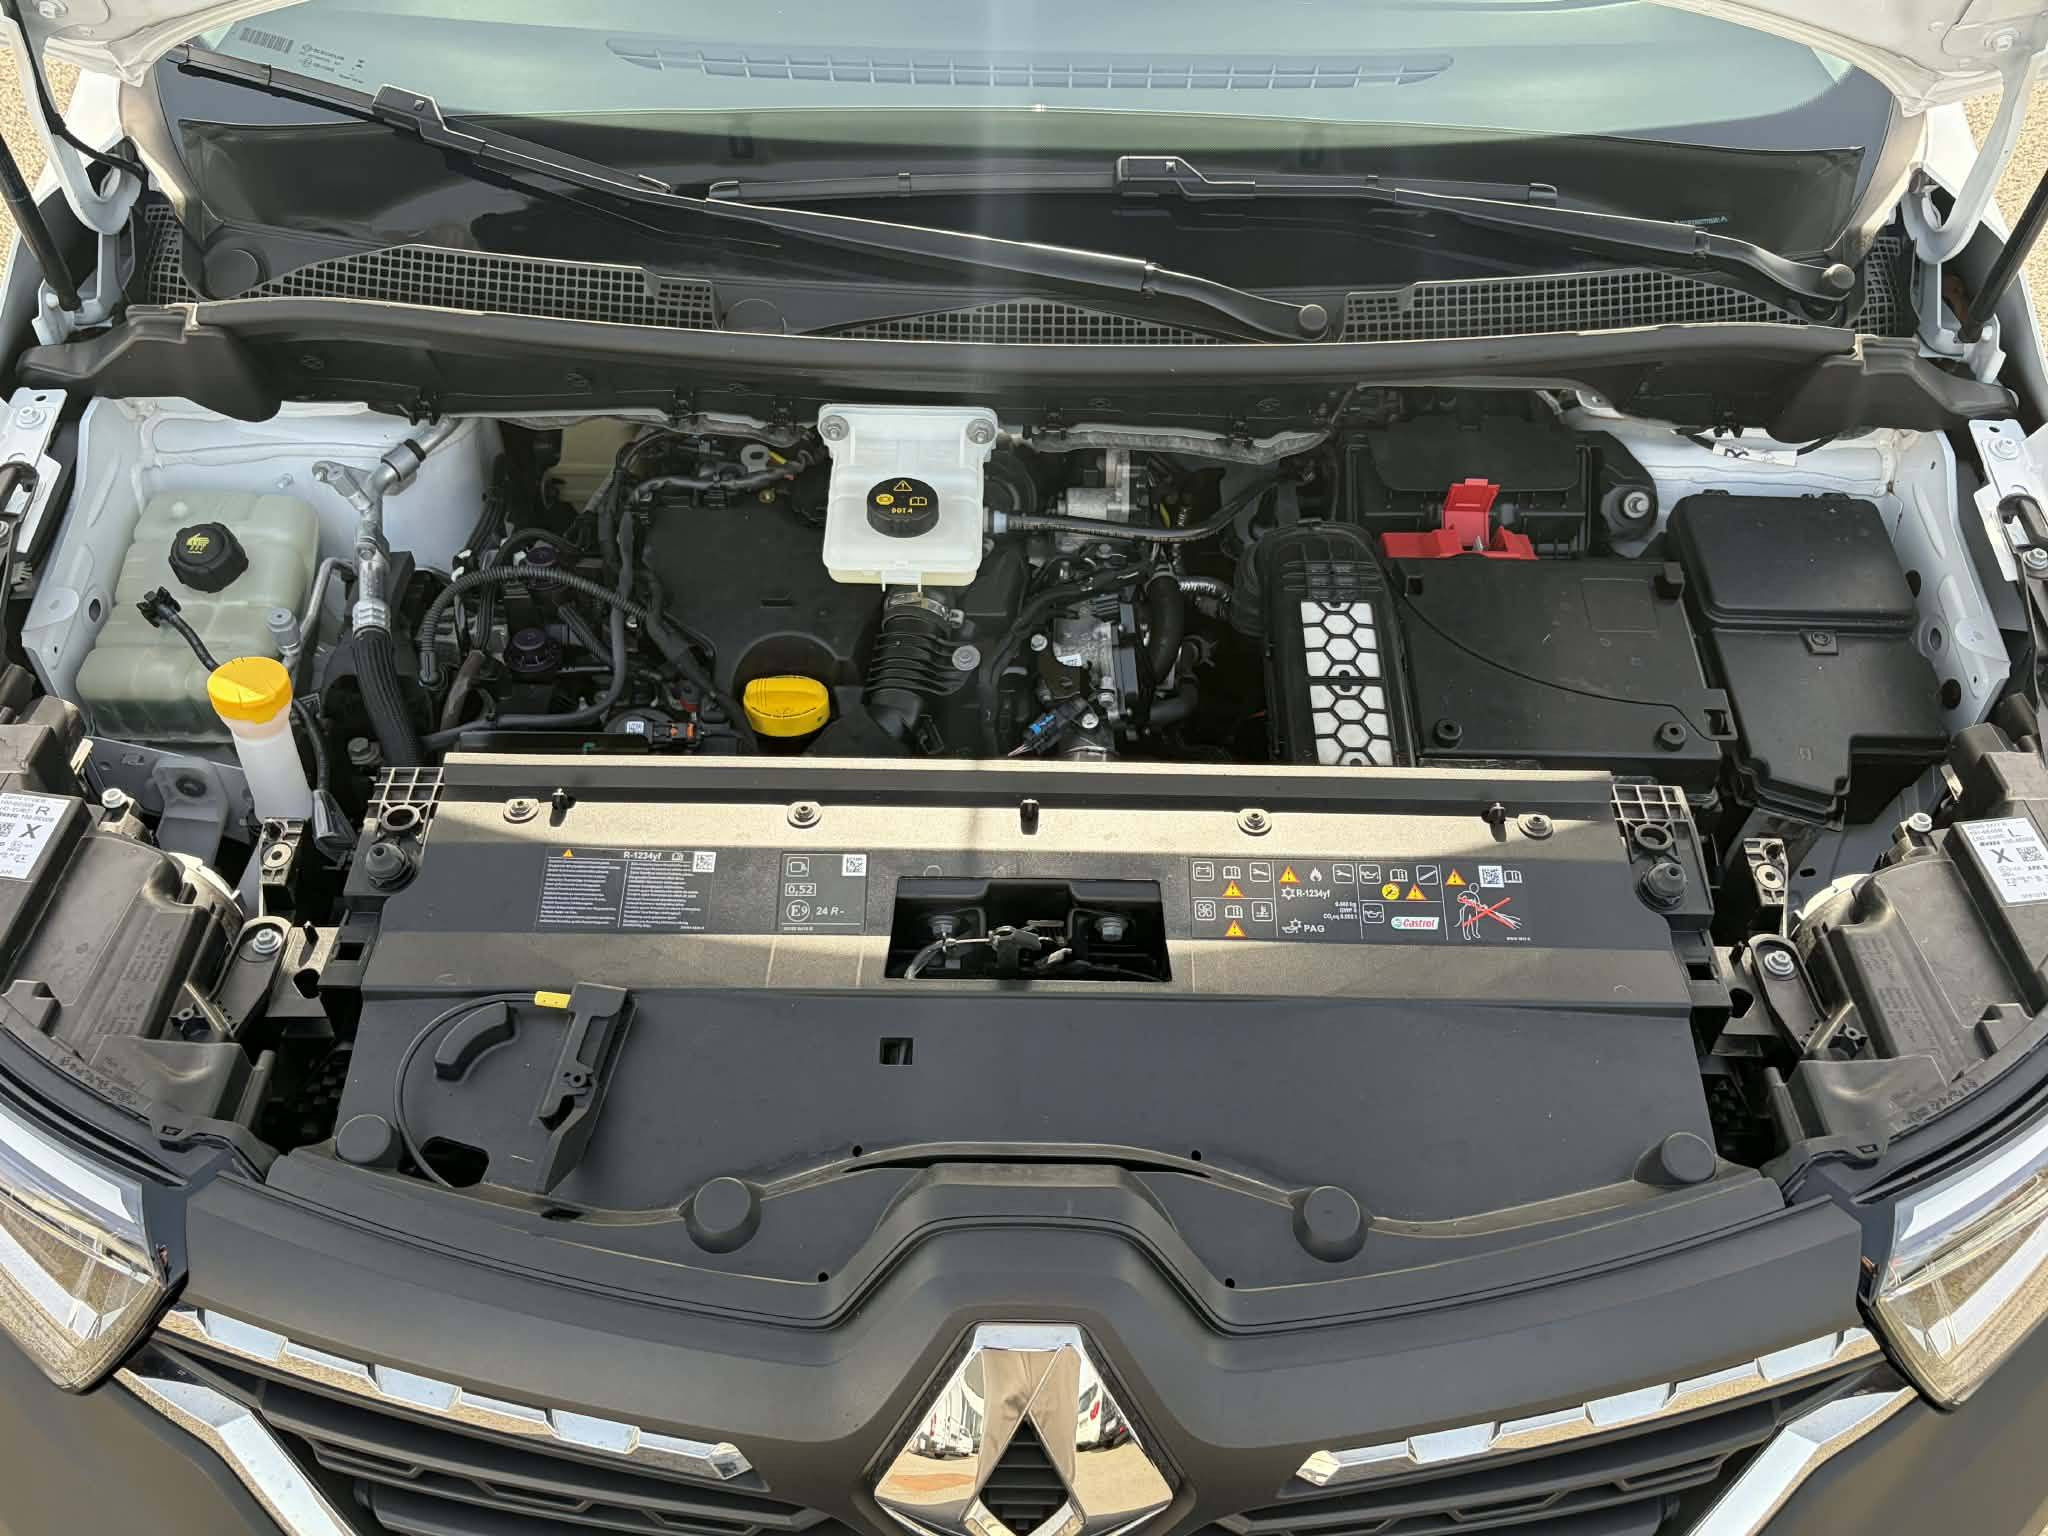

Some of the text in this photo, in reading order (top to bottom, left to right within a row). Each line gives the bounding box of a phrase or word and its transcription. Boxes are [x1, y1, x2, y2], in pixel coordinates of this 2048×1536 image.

[35, 806, 50, 816] R
[18, 823, 43, 840] X
[623, 851, 662, 861] R-1234yf
[1989, 847, 2015, 864] X
[788, 885, 813, 896] 0,52
[1296, 889, 1330, 899] R-1234yf
[815, 906, 828, 916] 24
[1303, 924, 1325, 933] PAG
[1403, 919, 1435, 928] Castrol
